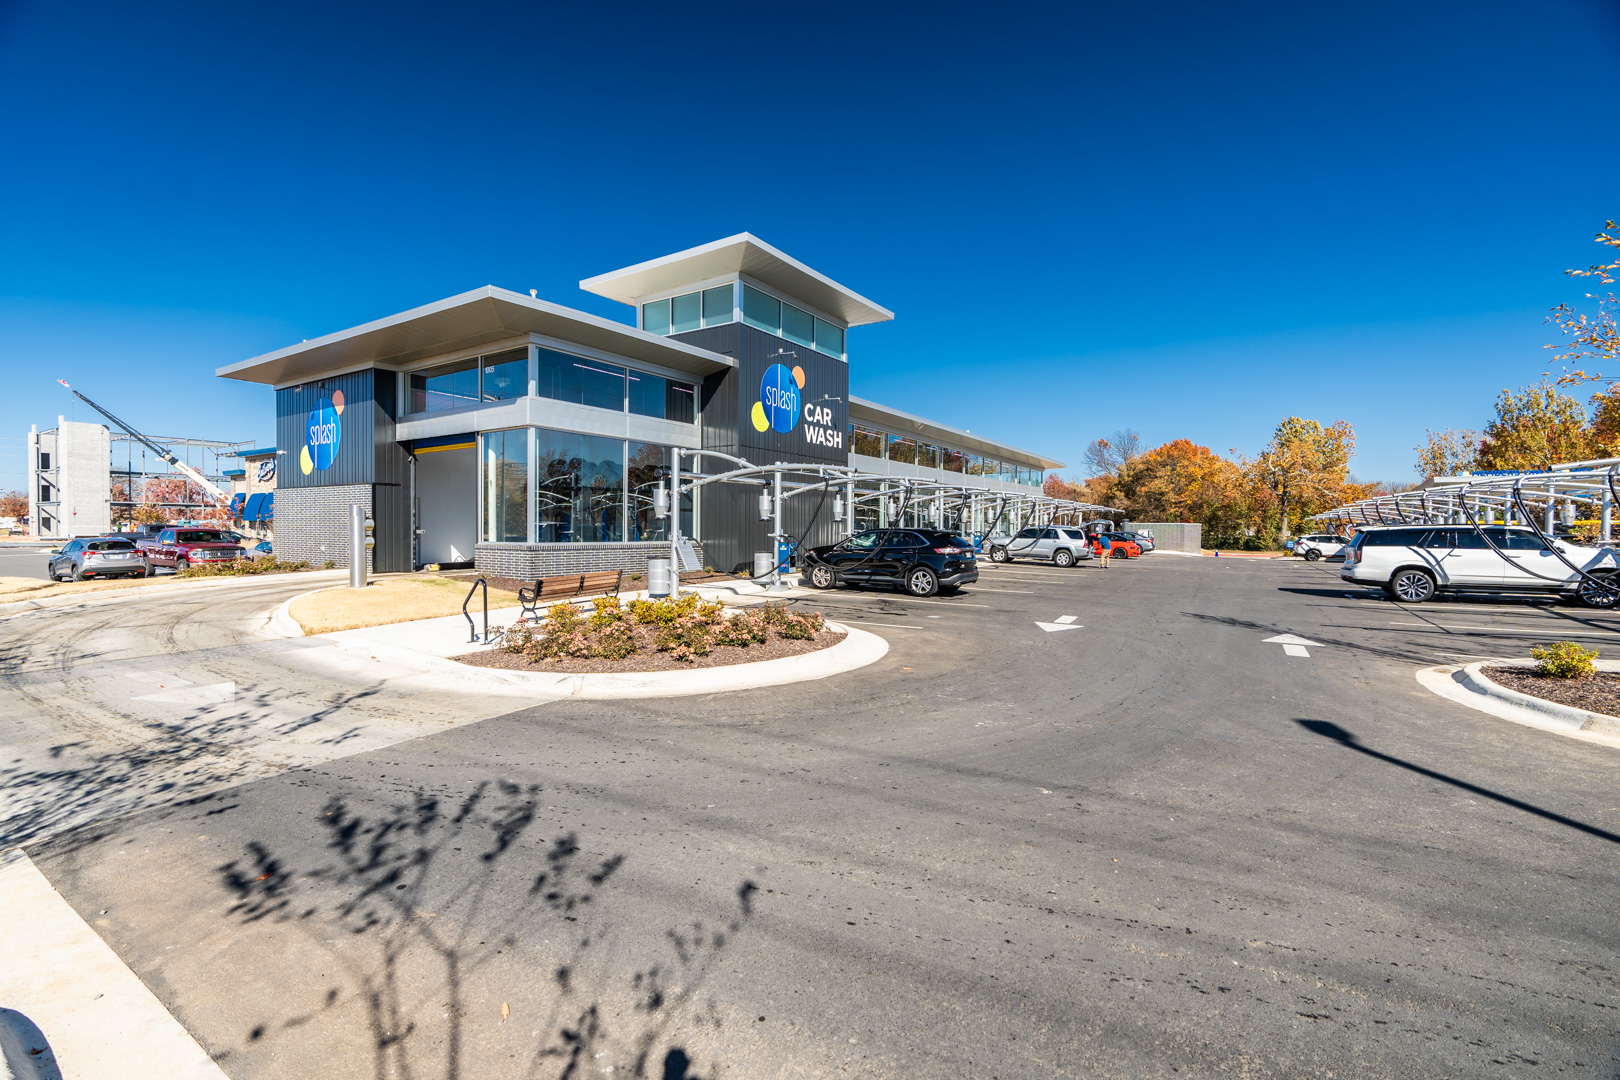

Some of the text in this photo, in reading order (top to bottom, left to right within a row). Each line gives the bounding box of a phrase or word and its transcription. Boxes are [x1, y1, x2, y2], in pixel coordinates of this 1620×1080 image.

[804, 403, 832, 426] CAR
[804, 424, 842, 449] WASH
[1471, 469, 1520, 477] MEMBERS
